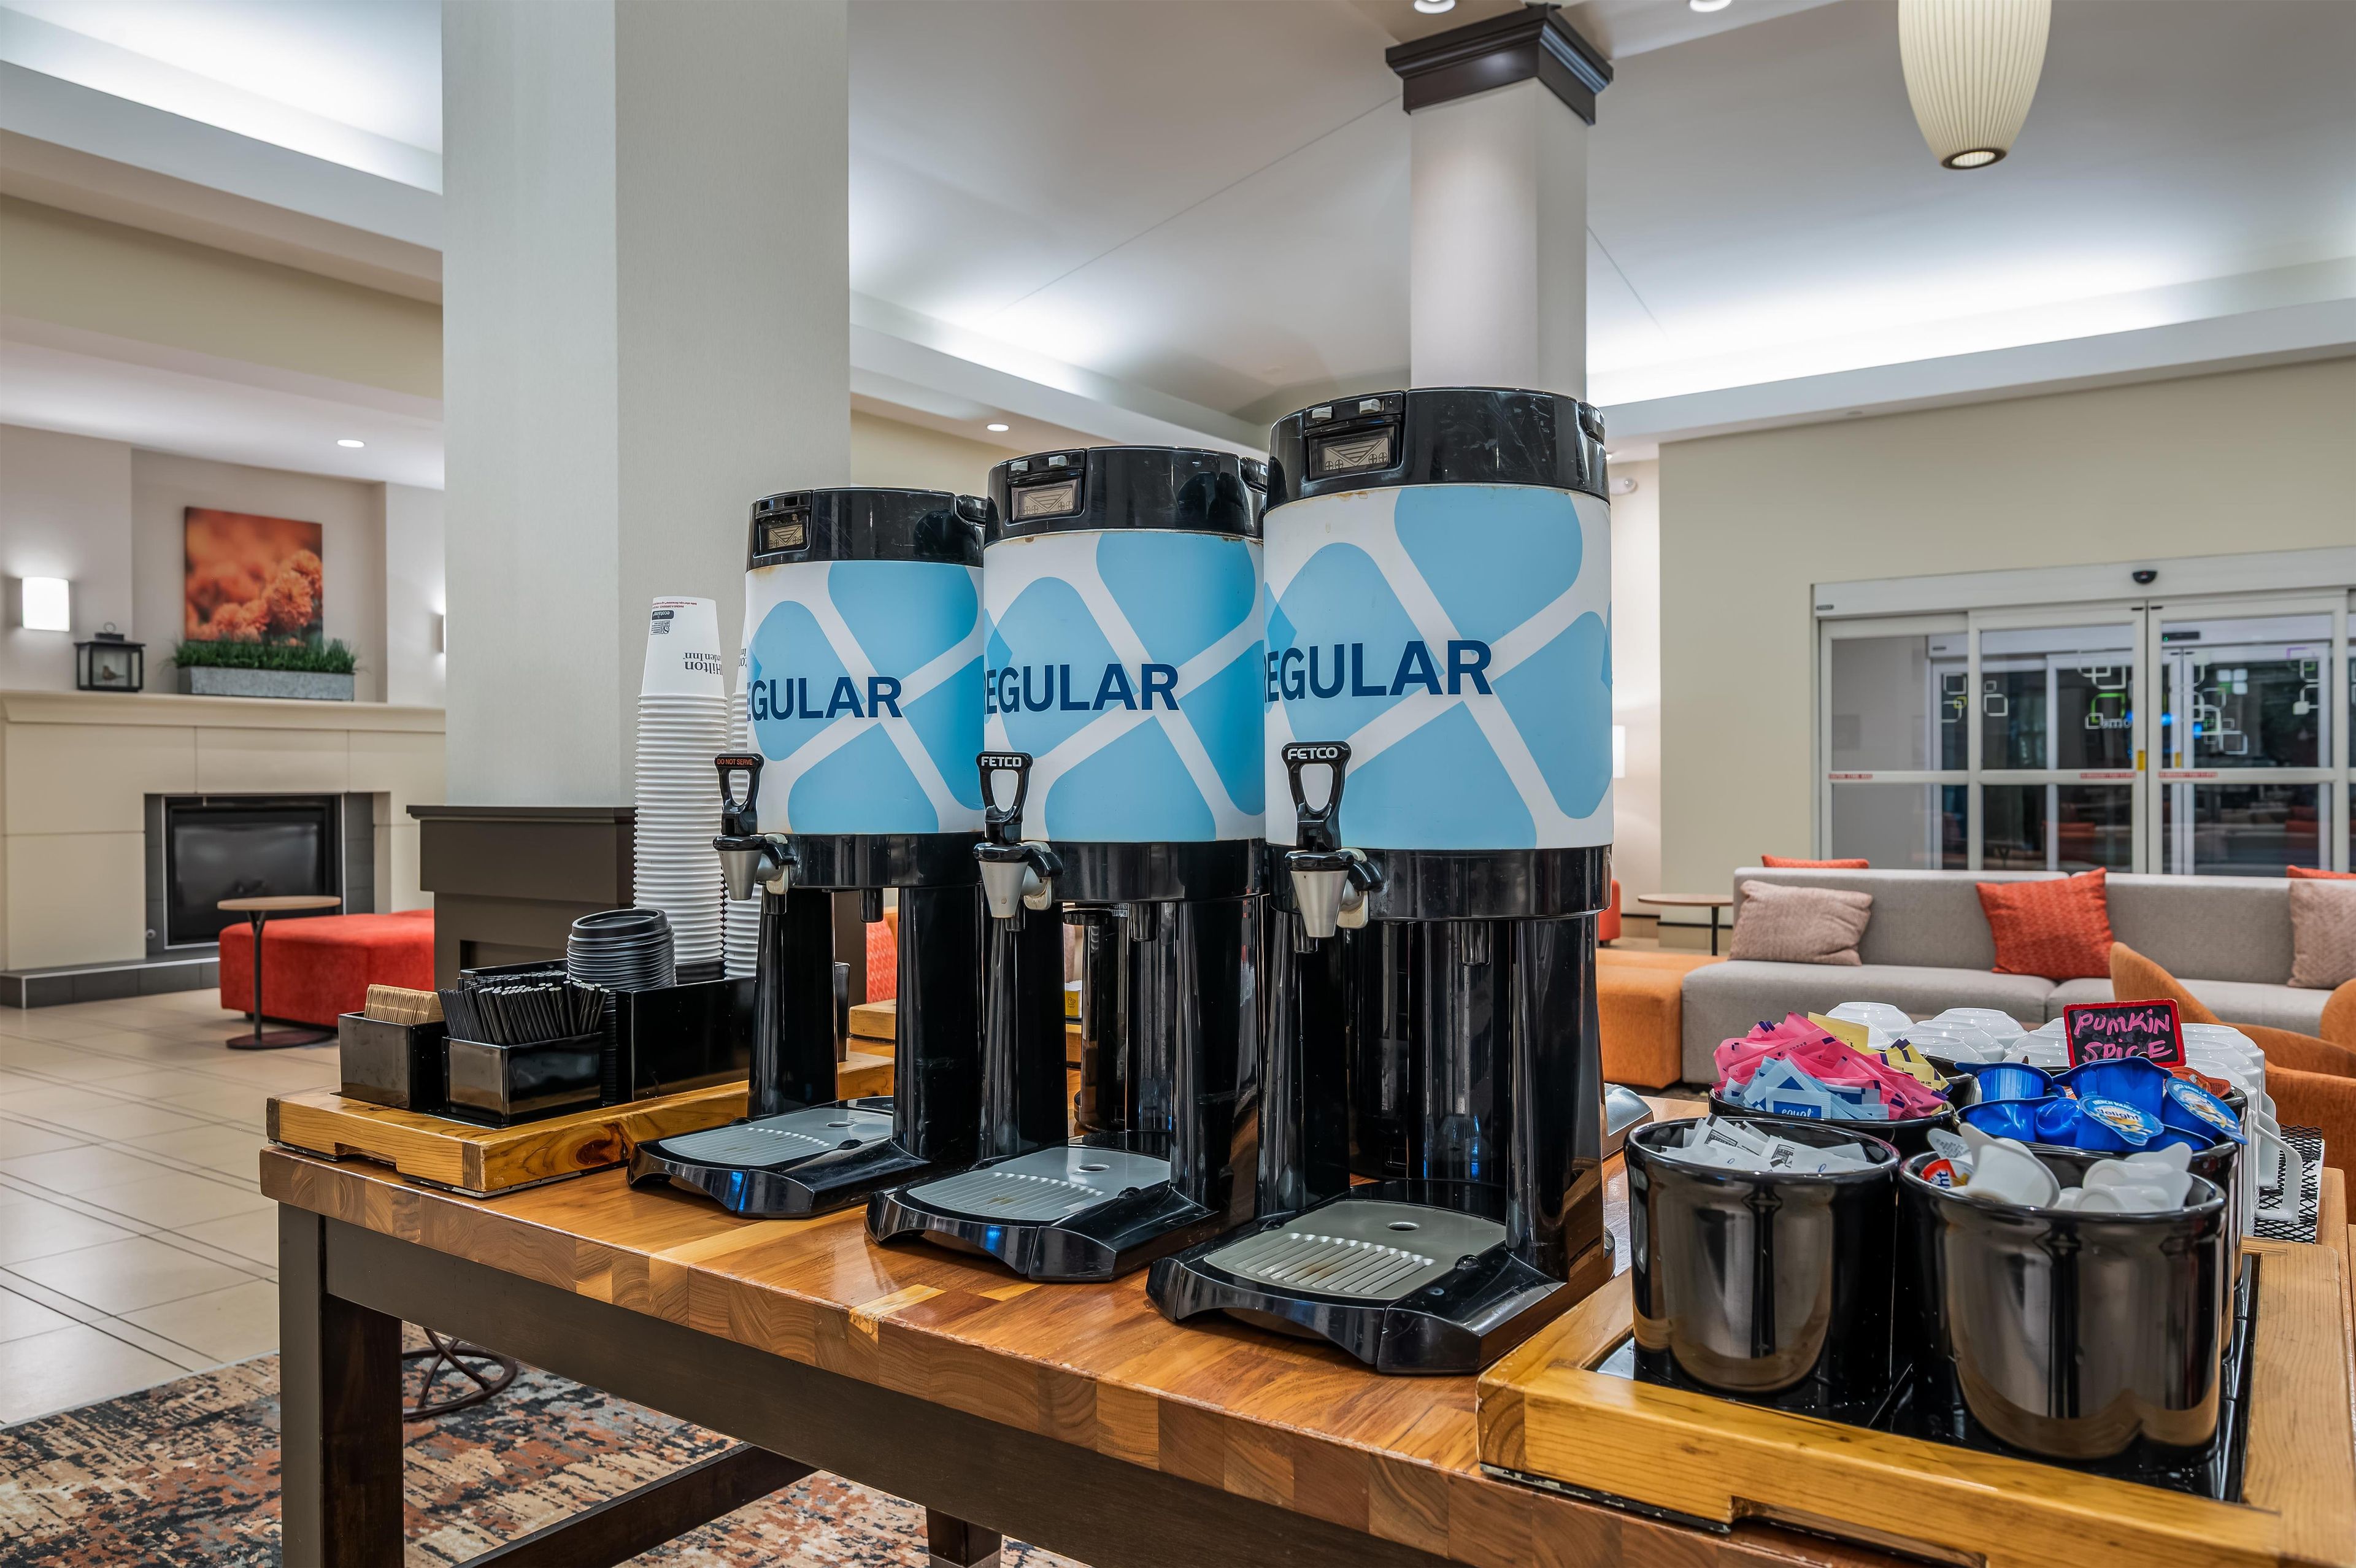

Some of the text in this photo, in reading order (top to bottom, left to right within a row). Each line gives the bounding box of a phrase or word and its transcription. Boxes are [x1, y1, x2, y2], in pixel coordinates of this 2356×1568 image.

[684, 653, 721, 663] rden Inn
[684, 661, 723, 676] Hilton
[984, 664, 1179, 715] EGULAR
[1288, 747, 1338, 759] FETCO
[982, 756, 1022, 767] FETCO
[2096, 1108, 2140, 1121] delight
